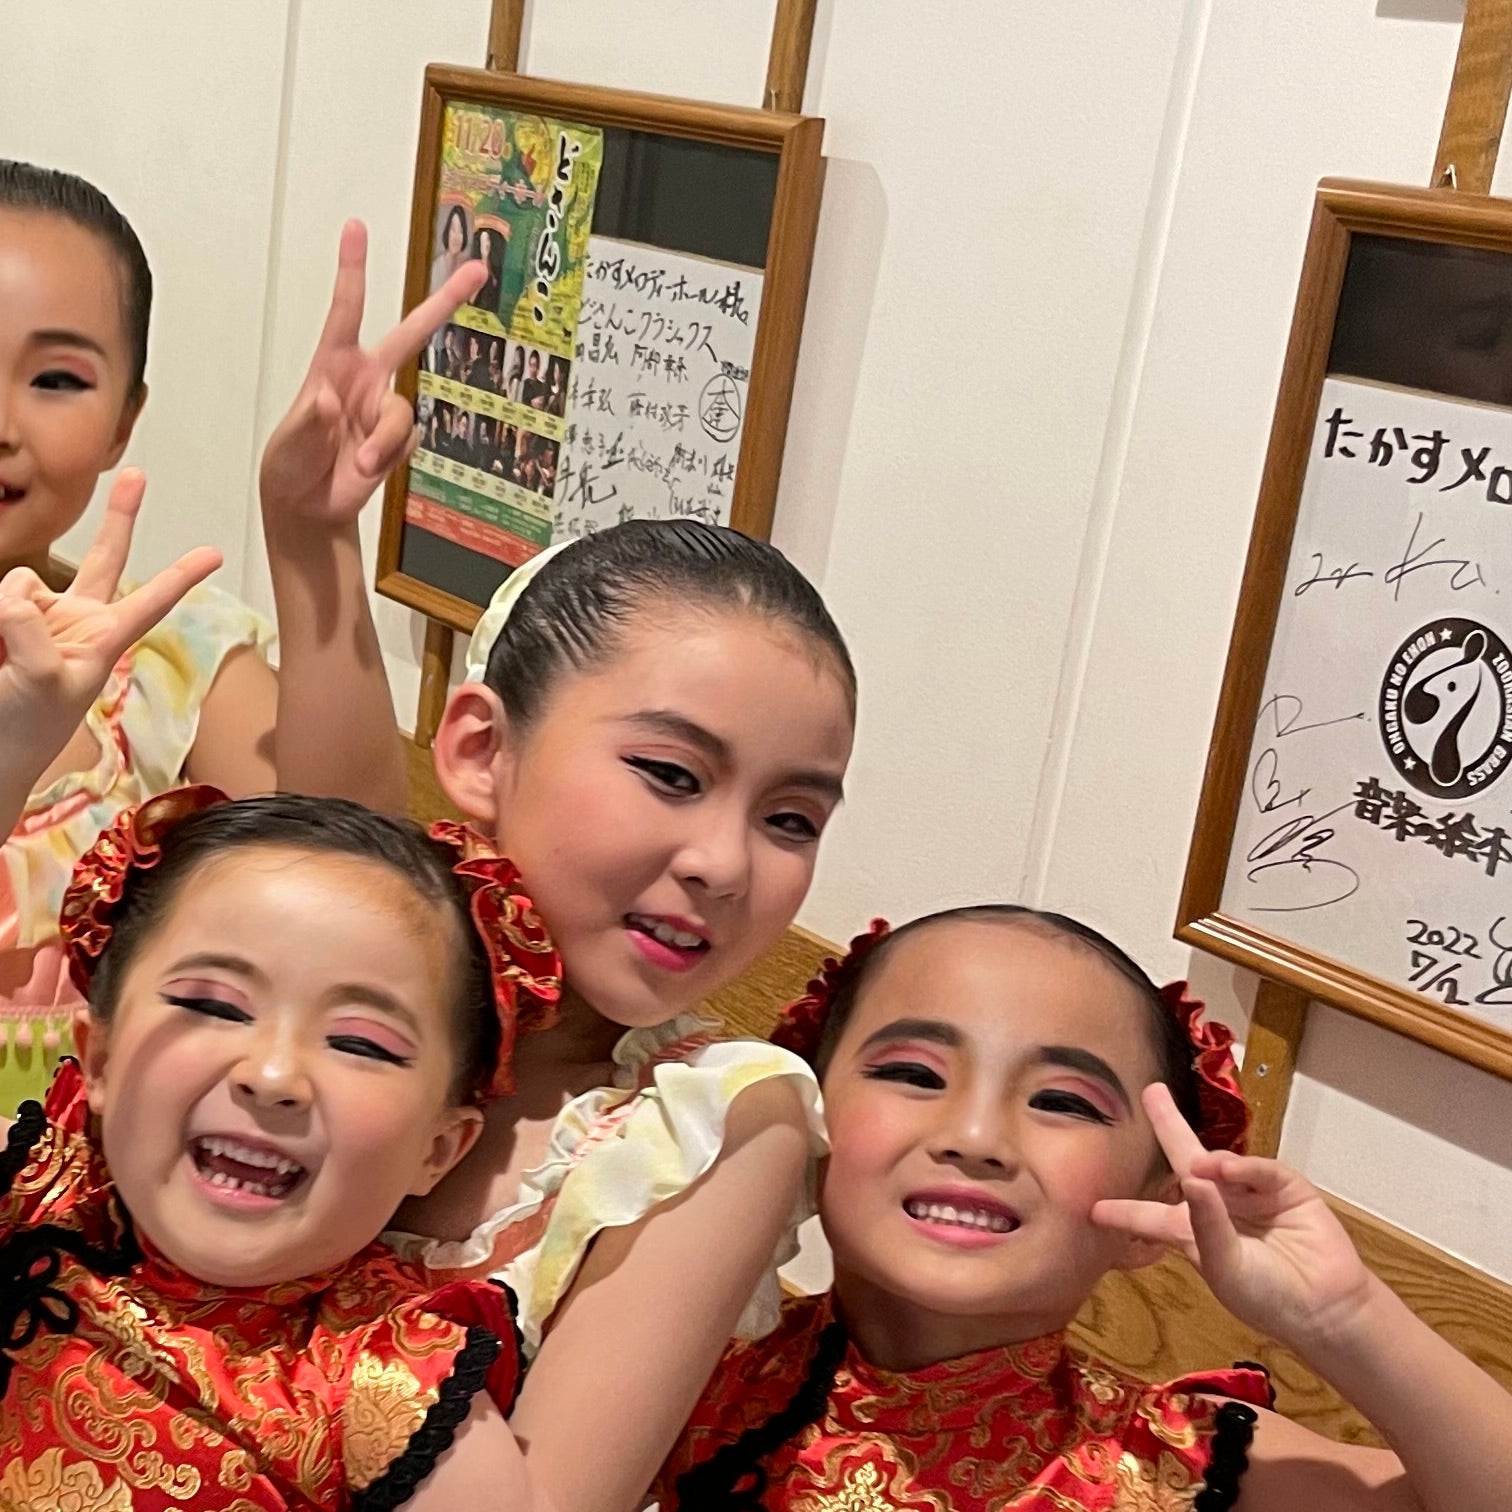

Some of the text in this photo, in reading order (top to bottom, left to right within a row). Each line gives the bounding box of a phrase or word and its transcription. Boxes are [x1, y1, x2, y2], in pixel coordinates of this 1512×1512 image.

[1324, 407, 1512, 506] たかすメロ
[1389, 662, 1408, 687] NO
[1466, 744, 1508, 787] BRASS
[1406, 919, 1483, 960] 2022
